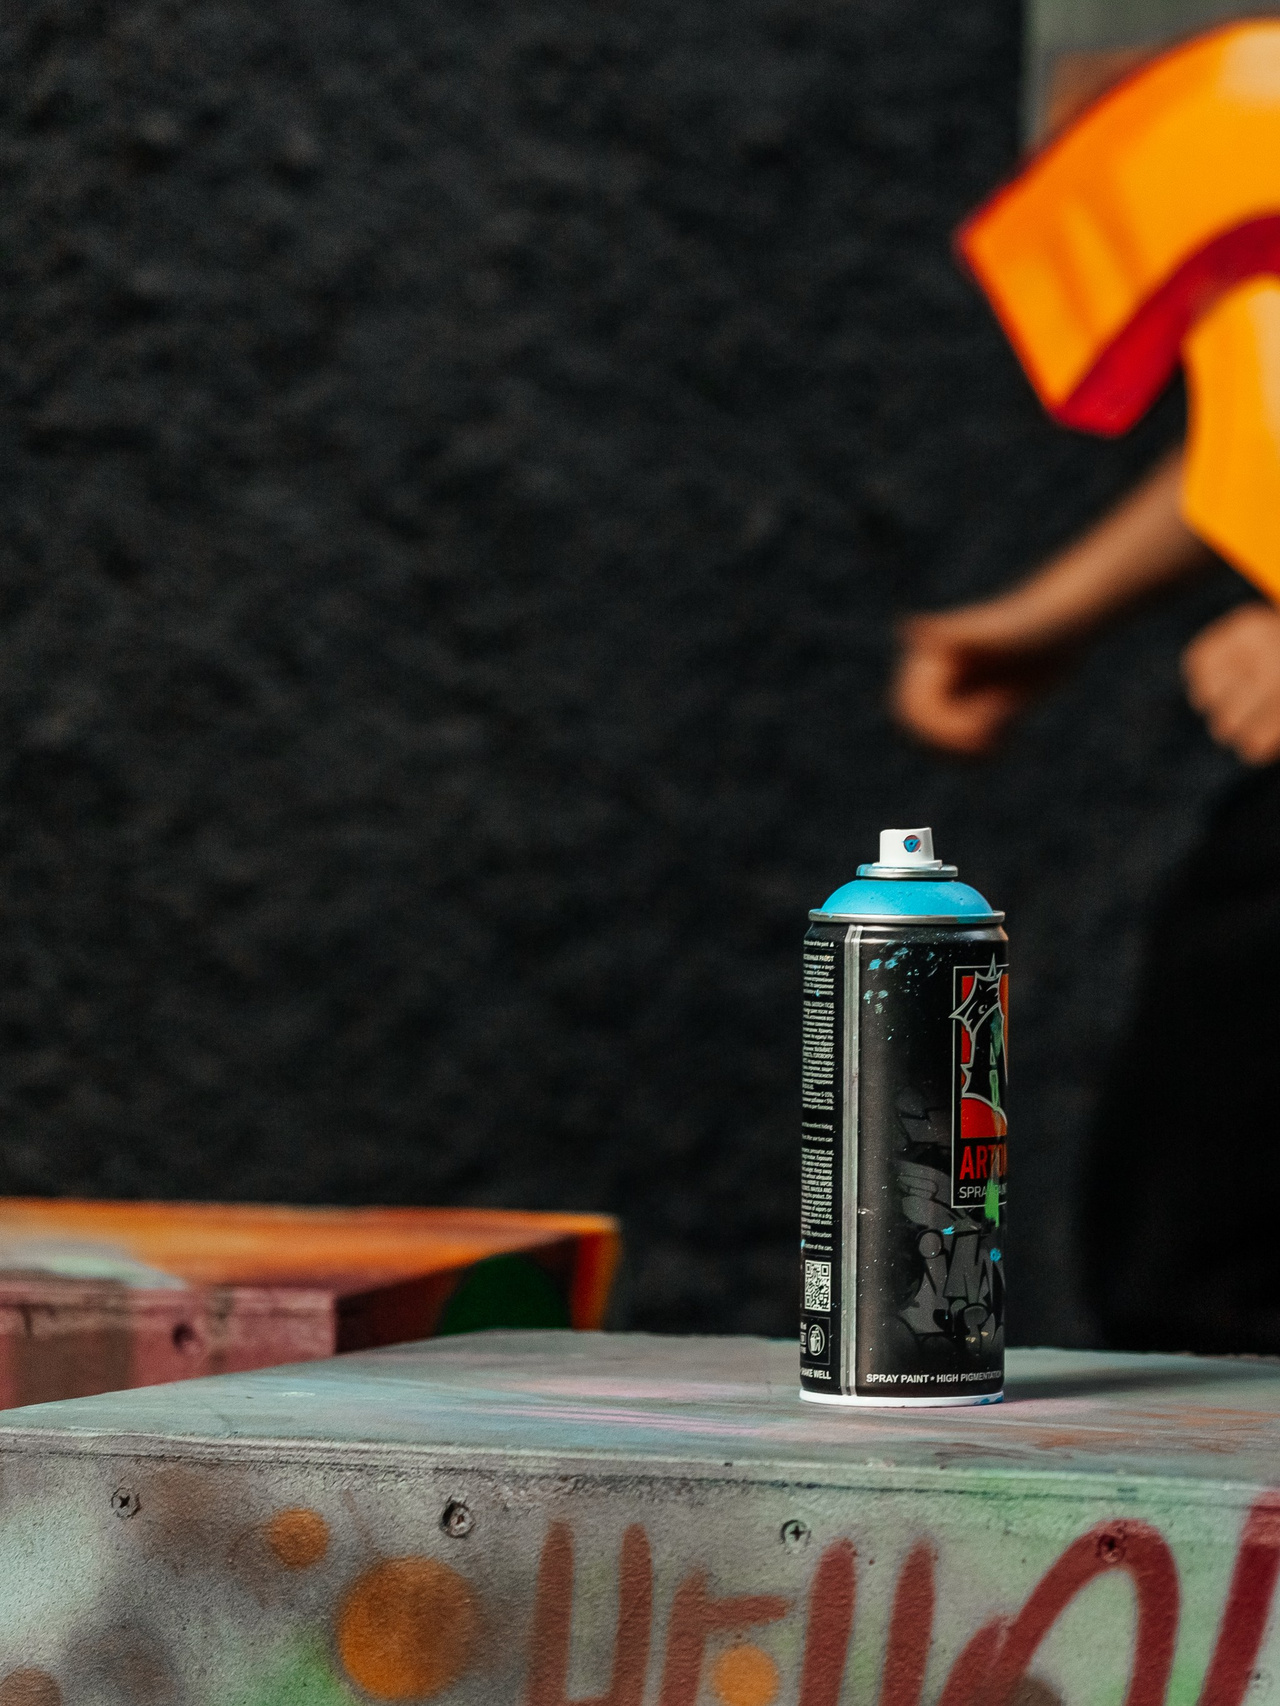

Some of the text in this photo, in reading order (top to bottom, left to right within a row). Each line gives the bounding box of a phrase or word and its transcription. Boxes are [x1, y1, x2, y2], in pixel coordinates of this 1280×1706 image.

[960, 1143, 1007, 1180] ARTO
[866, 1373, 899, 1383] SPRAY
[901, 1374, 929, 1384] PAINT
[936, 1374, 958, 1383] HIGH
